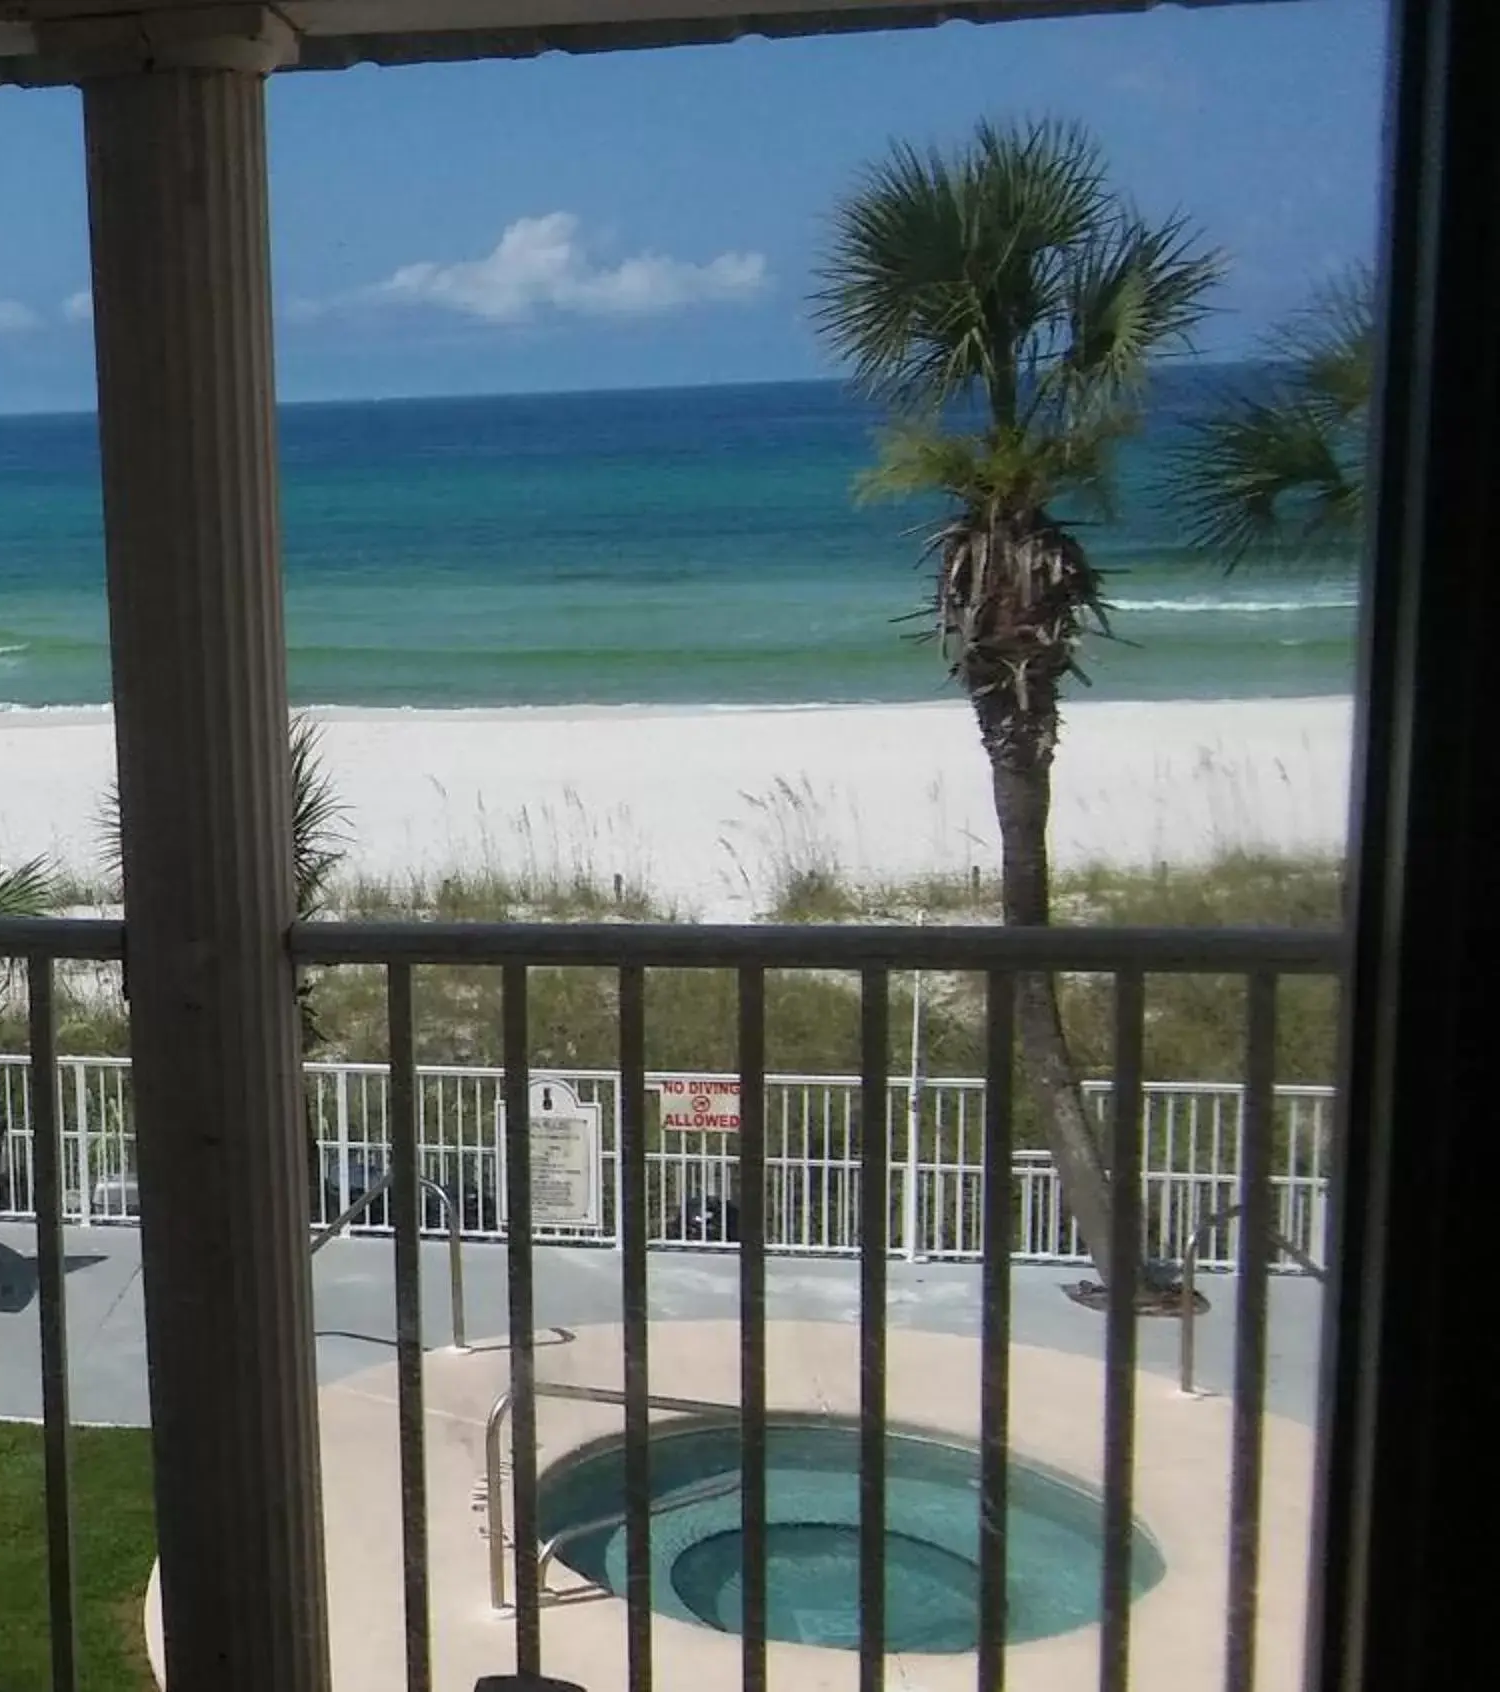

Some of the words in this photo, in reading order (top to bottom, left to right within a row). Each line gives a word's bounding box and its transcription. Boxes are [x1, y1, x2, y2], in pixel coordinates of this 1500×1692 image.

[663, 1081, 684, 1094] NO
[689, 1081, 740, 1094] DIVING
[665, 1114, 740, 1127] ALLOWED
